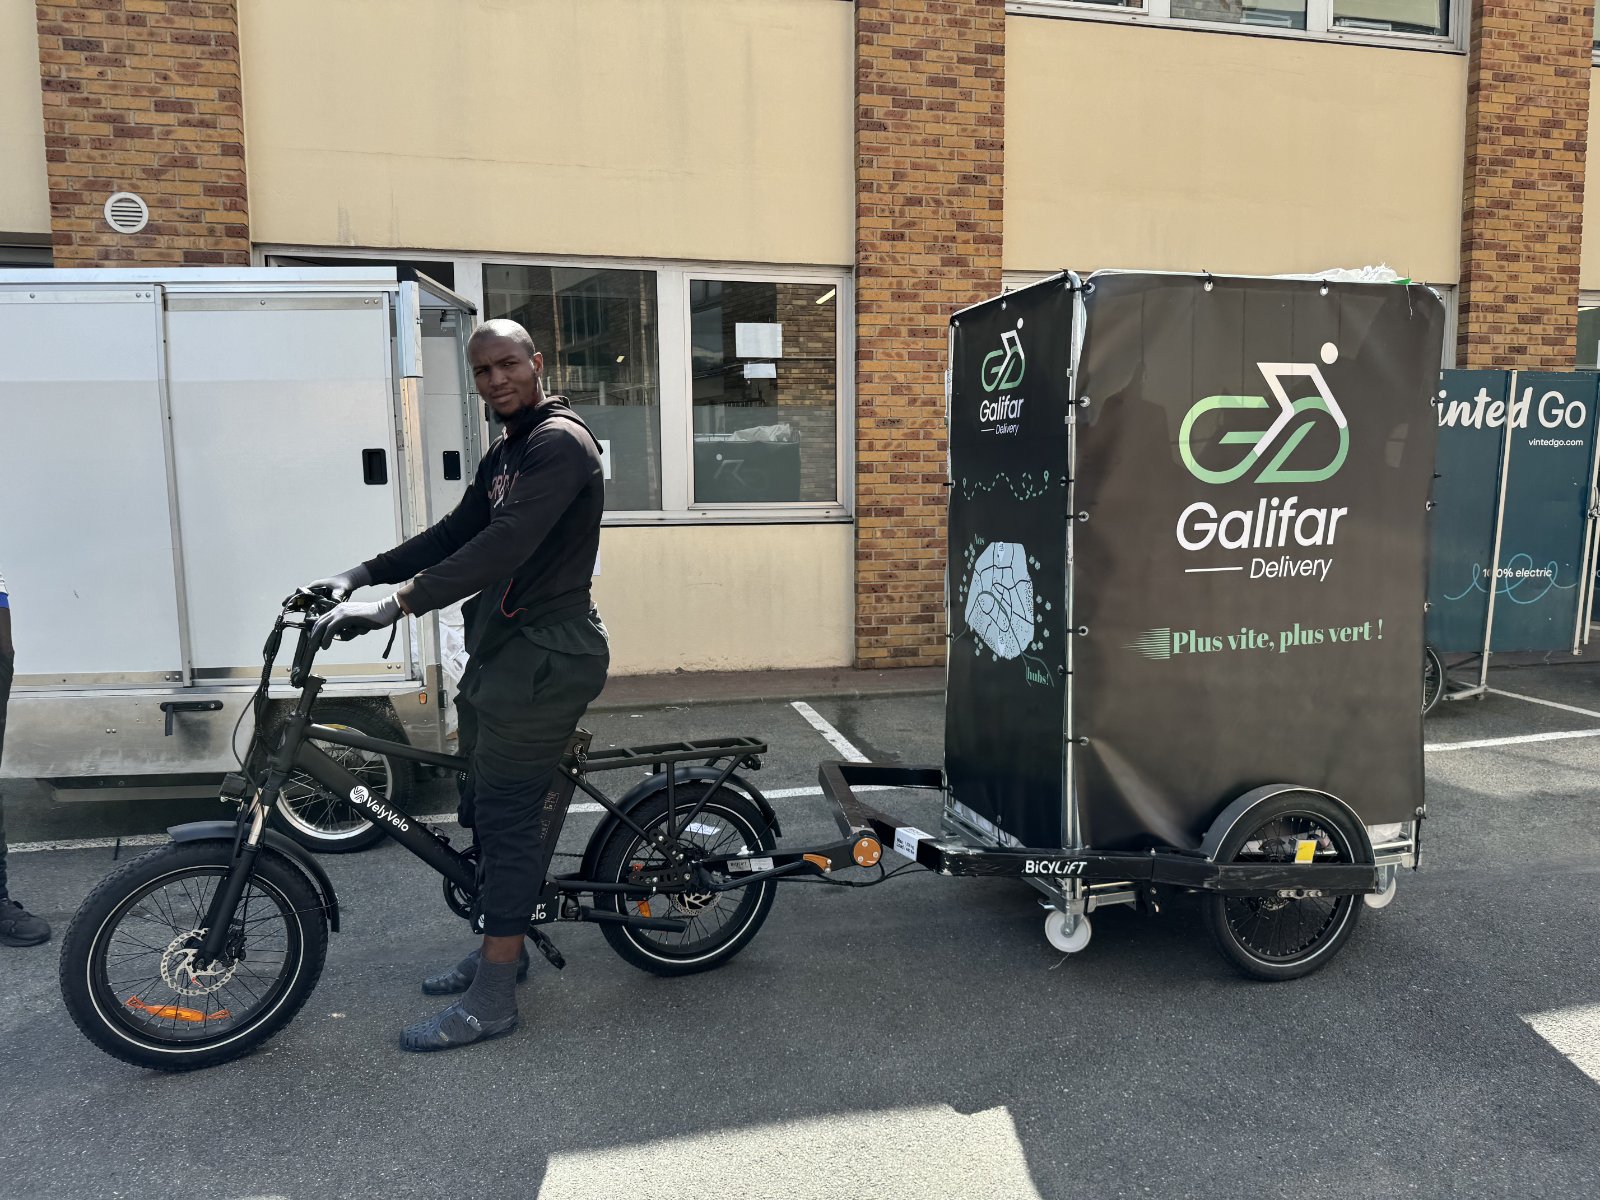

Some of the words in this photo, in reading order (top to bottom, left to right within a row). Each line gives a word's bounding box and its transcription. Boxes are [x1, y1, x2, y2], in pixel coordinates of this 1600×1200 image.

[979, 395, 1025, 423] Galifar
[1437, 387, 1534, 430] inted
[1538, 390, 1587, 429] Go
[995, 423, 1019, 436] Delivery
[1528, 437, 1584, 448] vintedgo.com
[1176, 496, 1348, 551] Galifar
[1250, 556, 1333, 582] Delivery
[1515, 568, 1552, 578] electric
[1172, 629, 1223, 655] Plus
[1227, 627, 1275, 652] vite,
[1279, 622, 1324, 654] plus
[1328, 620, 1373, 643] vert
[1377, 618, 1384, 641] !
[365, 796, 410, 832] VelyVelo
